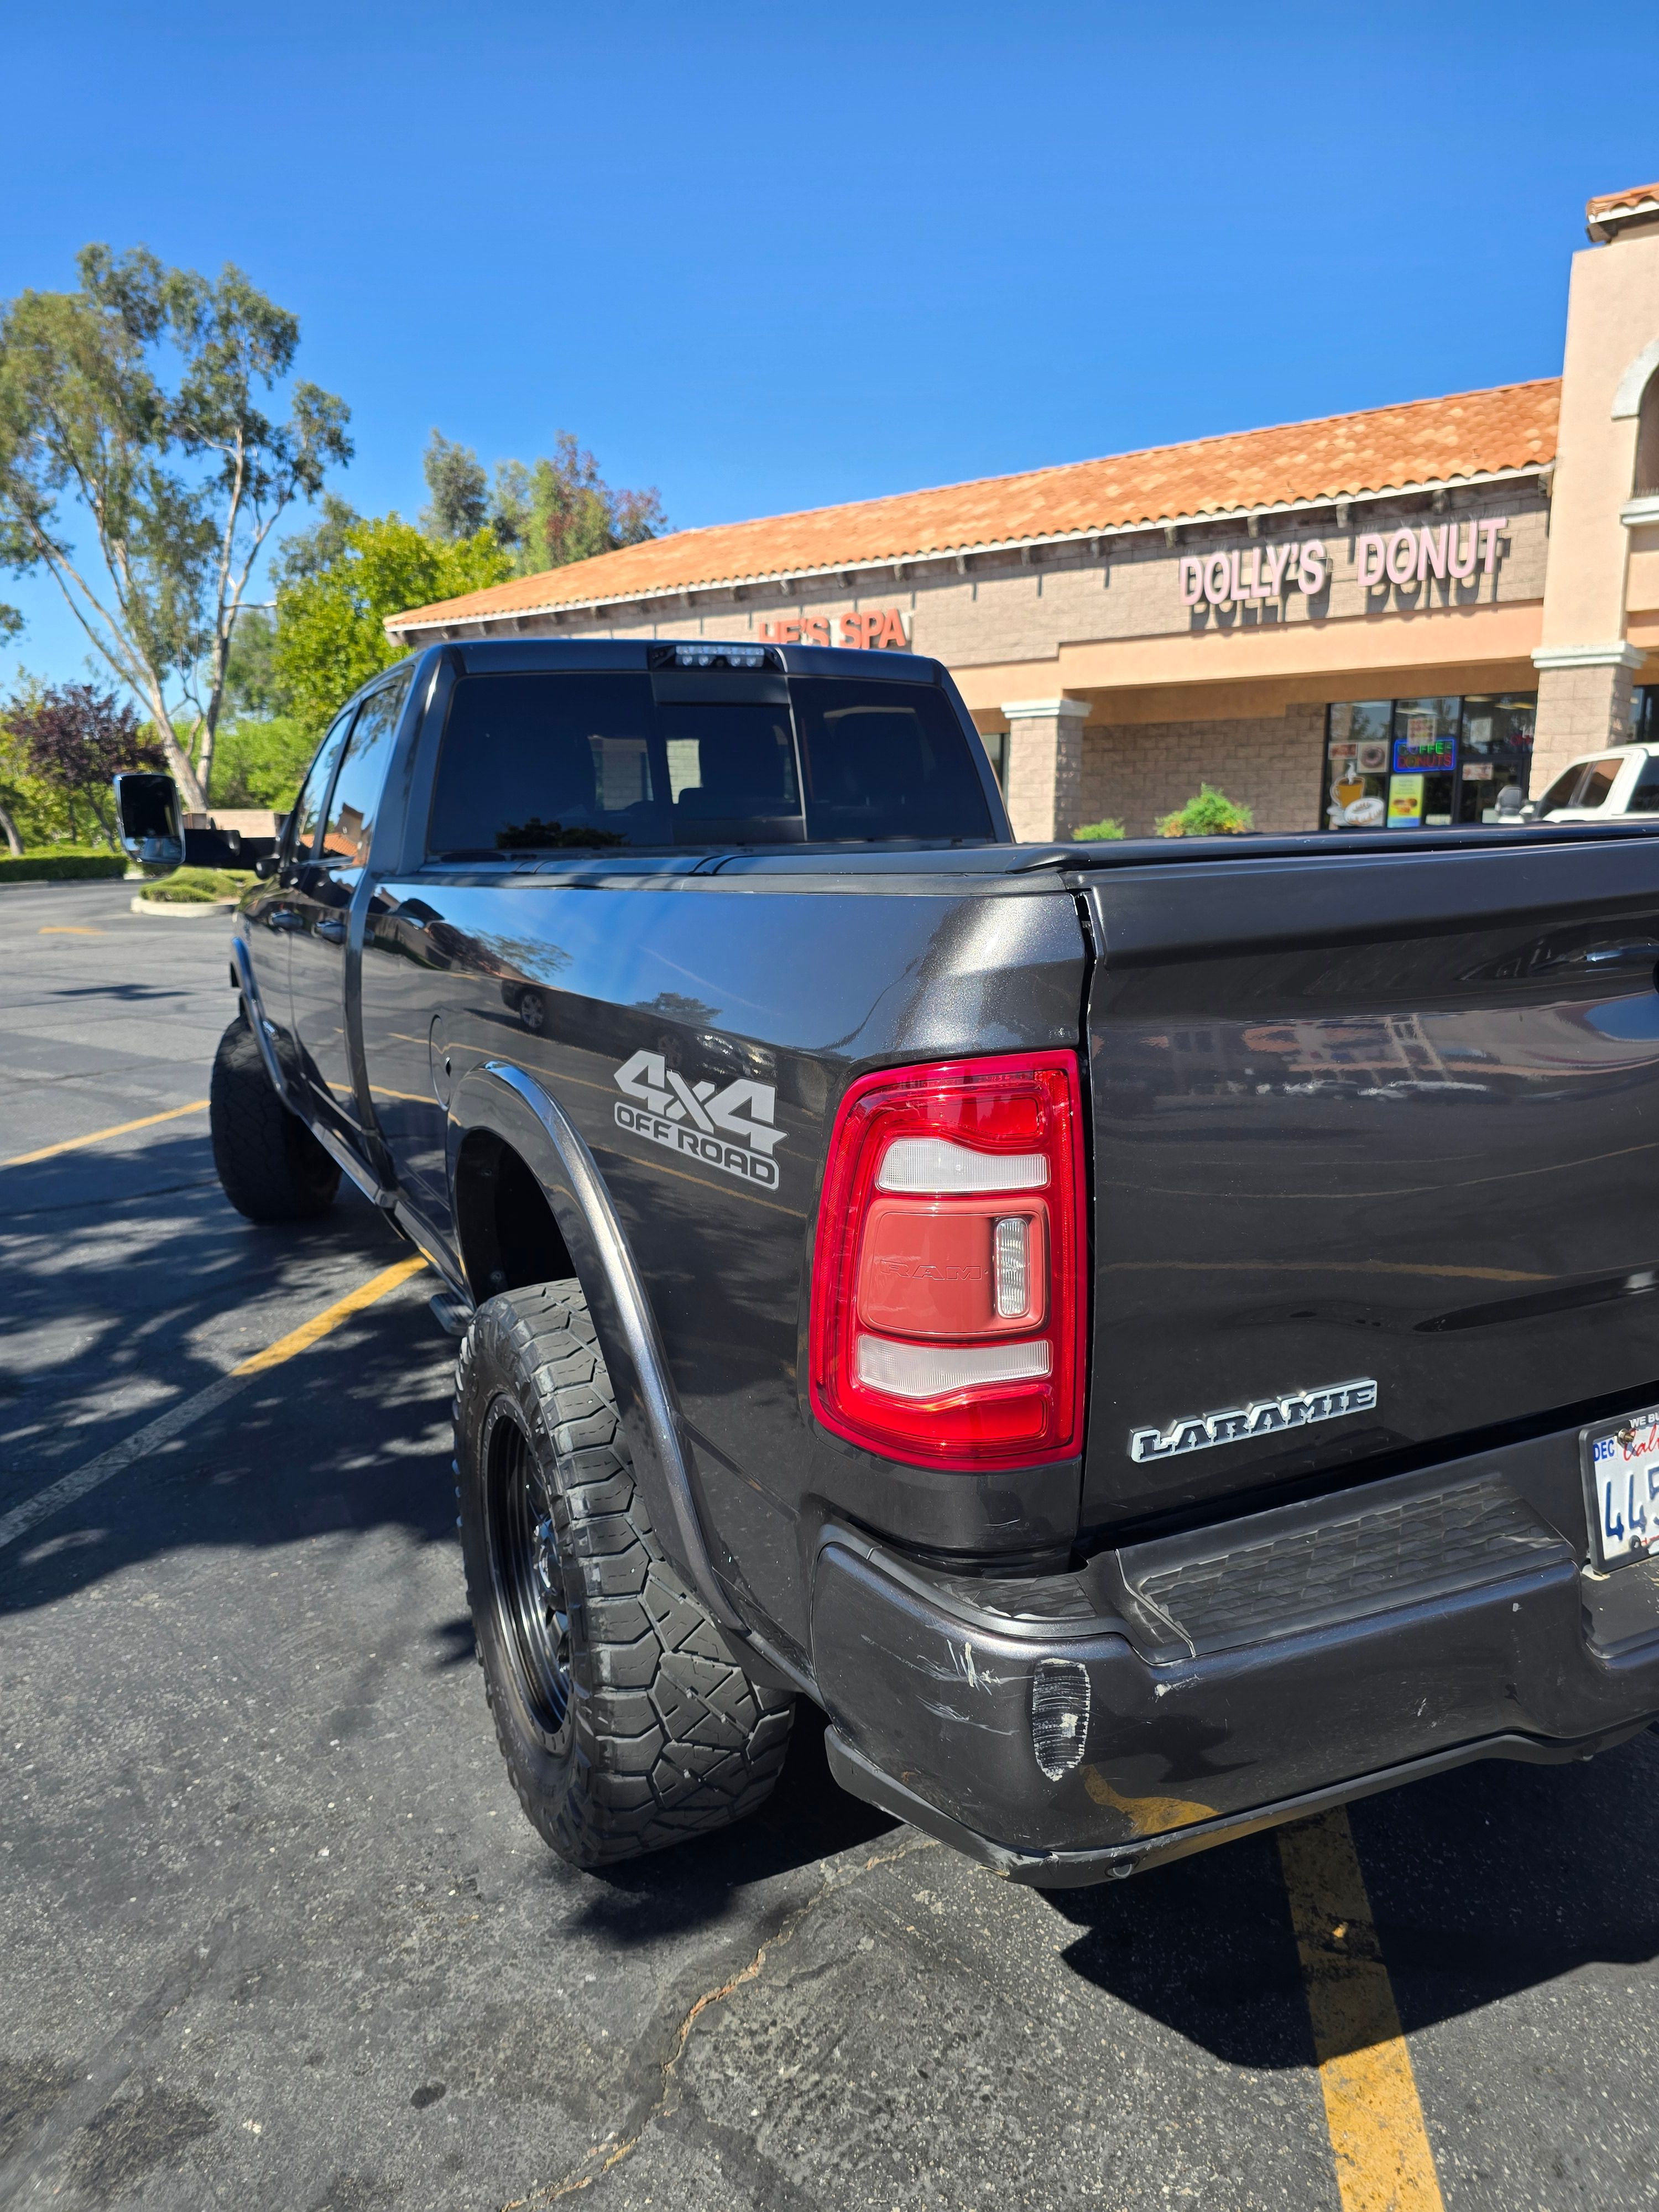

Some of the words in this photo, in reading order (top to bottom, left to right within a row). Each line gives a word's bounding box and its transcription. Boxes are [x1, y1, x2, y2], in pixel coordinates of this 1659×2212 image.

[1180, 539, 1327, 606] DOLLY'S
[1357, 517, 1508, 587] DONUT
[839, 607, 906, 649] SPA
[1397, 753, 1452, 769] DONUTS
[617, 1105, 672, 1140] OFF
[677, 1128, 776, 1185] ROAD
[880, 1259, 982, 1281] RAM
[1130, 1379, 1378, 1463] LARAMIE
[1629, 1416, 1646, 1428] WE
[1593, 1439, 1615, 1462] DEC
